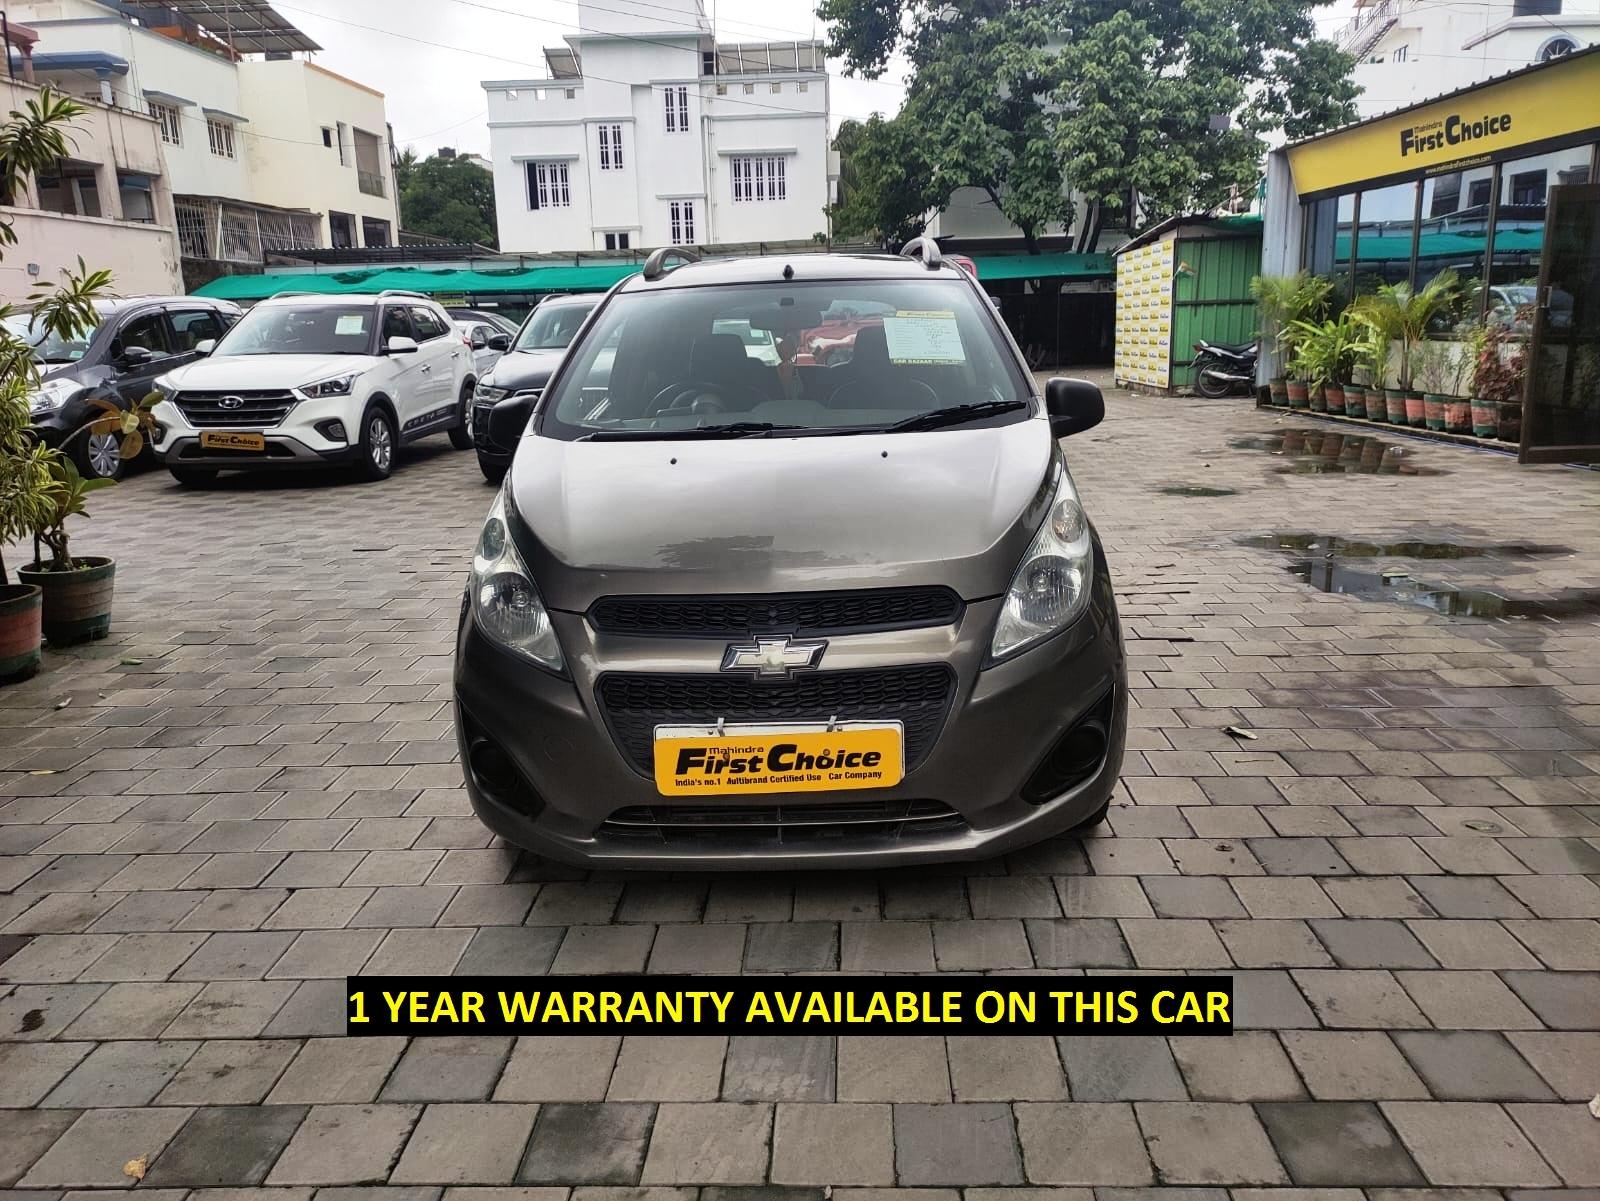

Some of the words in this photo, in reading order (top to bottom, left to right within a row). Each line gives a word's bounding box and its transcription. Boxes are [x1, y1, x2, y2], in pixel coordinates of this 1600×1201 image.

[1400, 128, 1444, 157] First
[1445, 114, 1512, 146] Choice
[230, 436, 260, 446] Choice
[675, 748, 764, 775] First
[767, 744, 881, 772] Choice
[675, 779, 702, 787] India's
[704, 778, 721, 786] no.1
[770, 774, 804, 783] Certified
[829, 772, 842, 780] Car
[844, 770, 882, 780] Company
